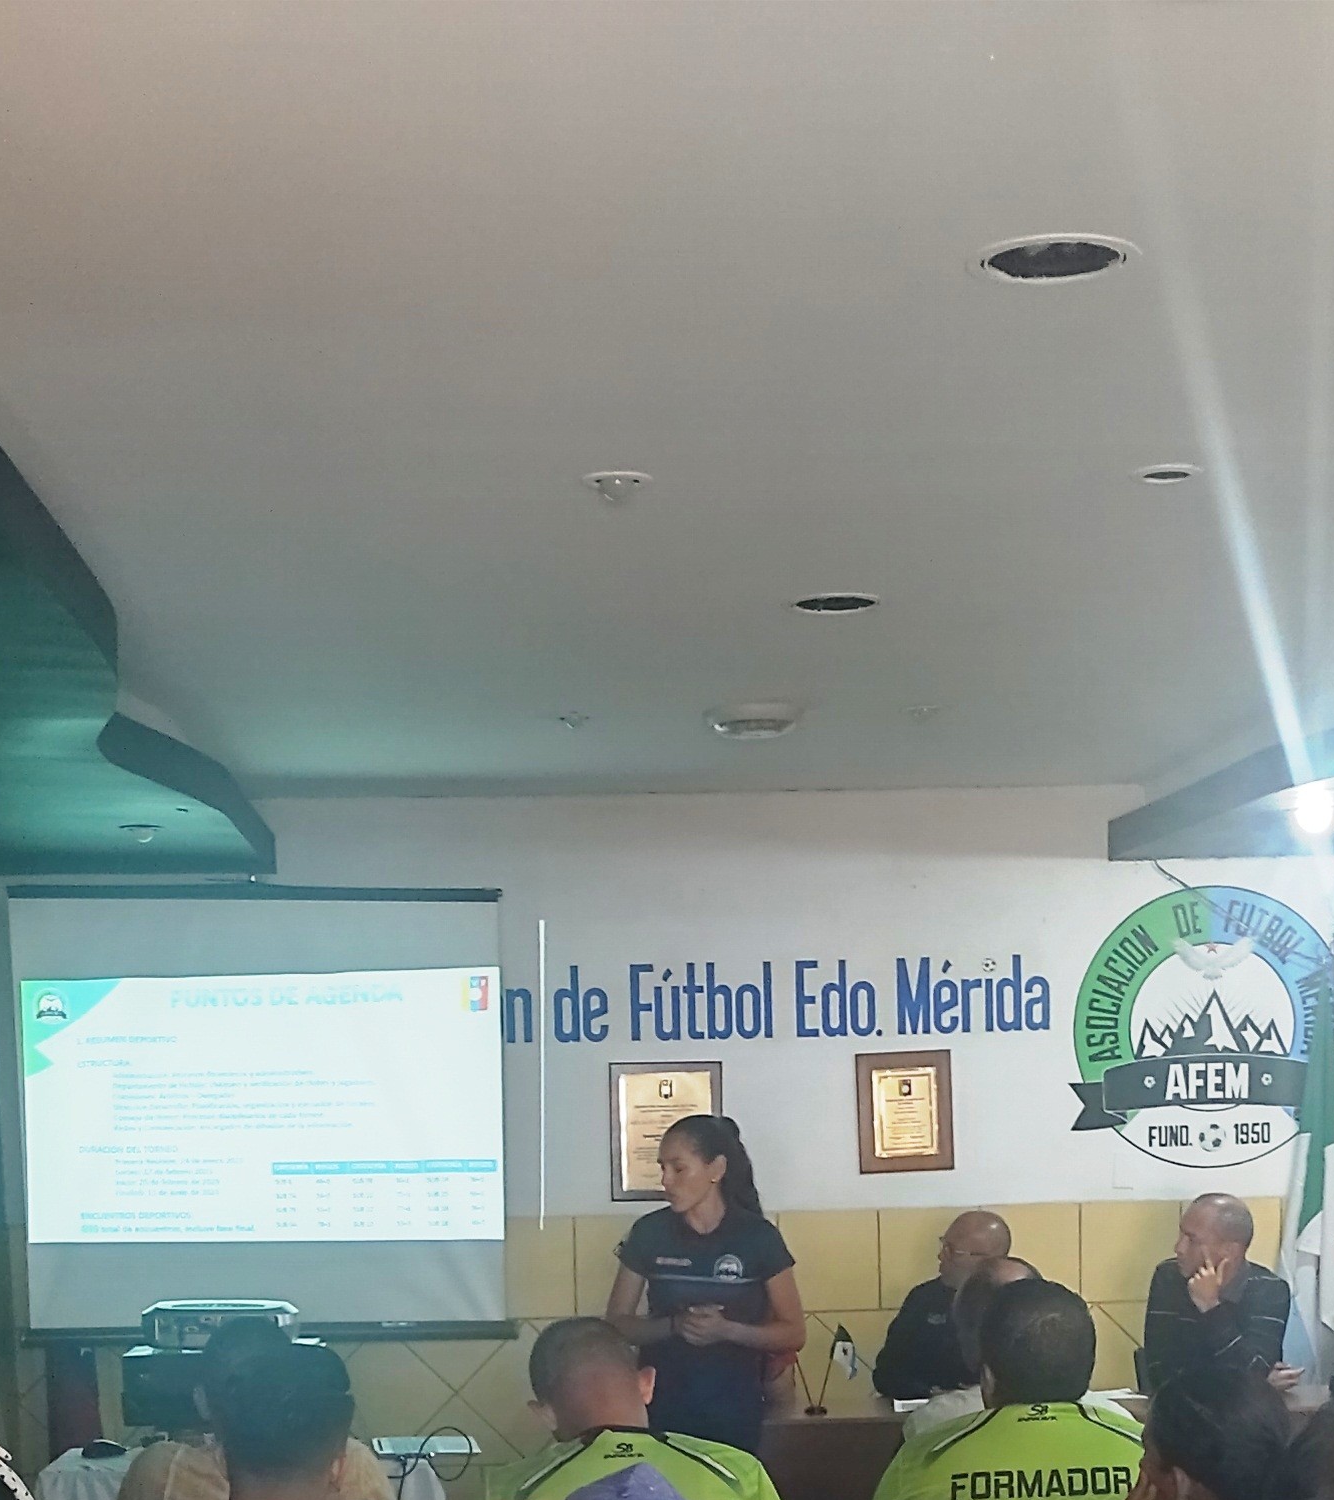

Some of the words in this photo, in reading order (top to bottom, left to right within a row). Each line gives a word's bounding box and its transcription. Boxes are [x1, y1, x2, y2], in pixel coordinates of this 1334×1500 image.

[554, 965, 609, 1043] de
[630, 961, 773, 1042] Fútbol
[795, 959, 883, 1039] Edo.
[896, 953, 1051, 1036] Mérida
[1085, 924, 1159, 1063] ASOCIACION
[1172, 901, 1203, 938] DE
[1165, 1062, 1250, 1101] AFEM
[1233, 1122, 1271, 1145] 1950
